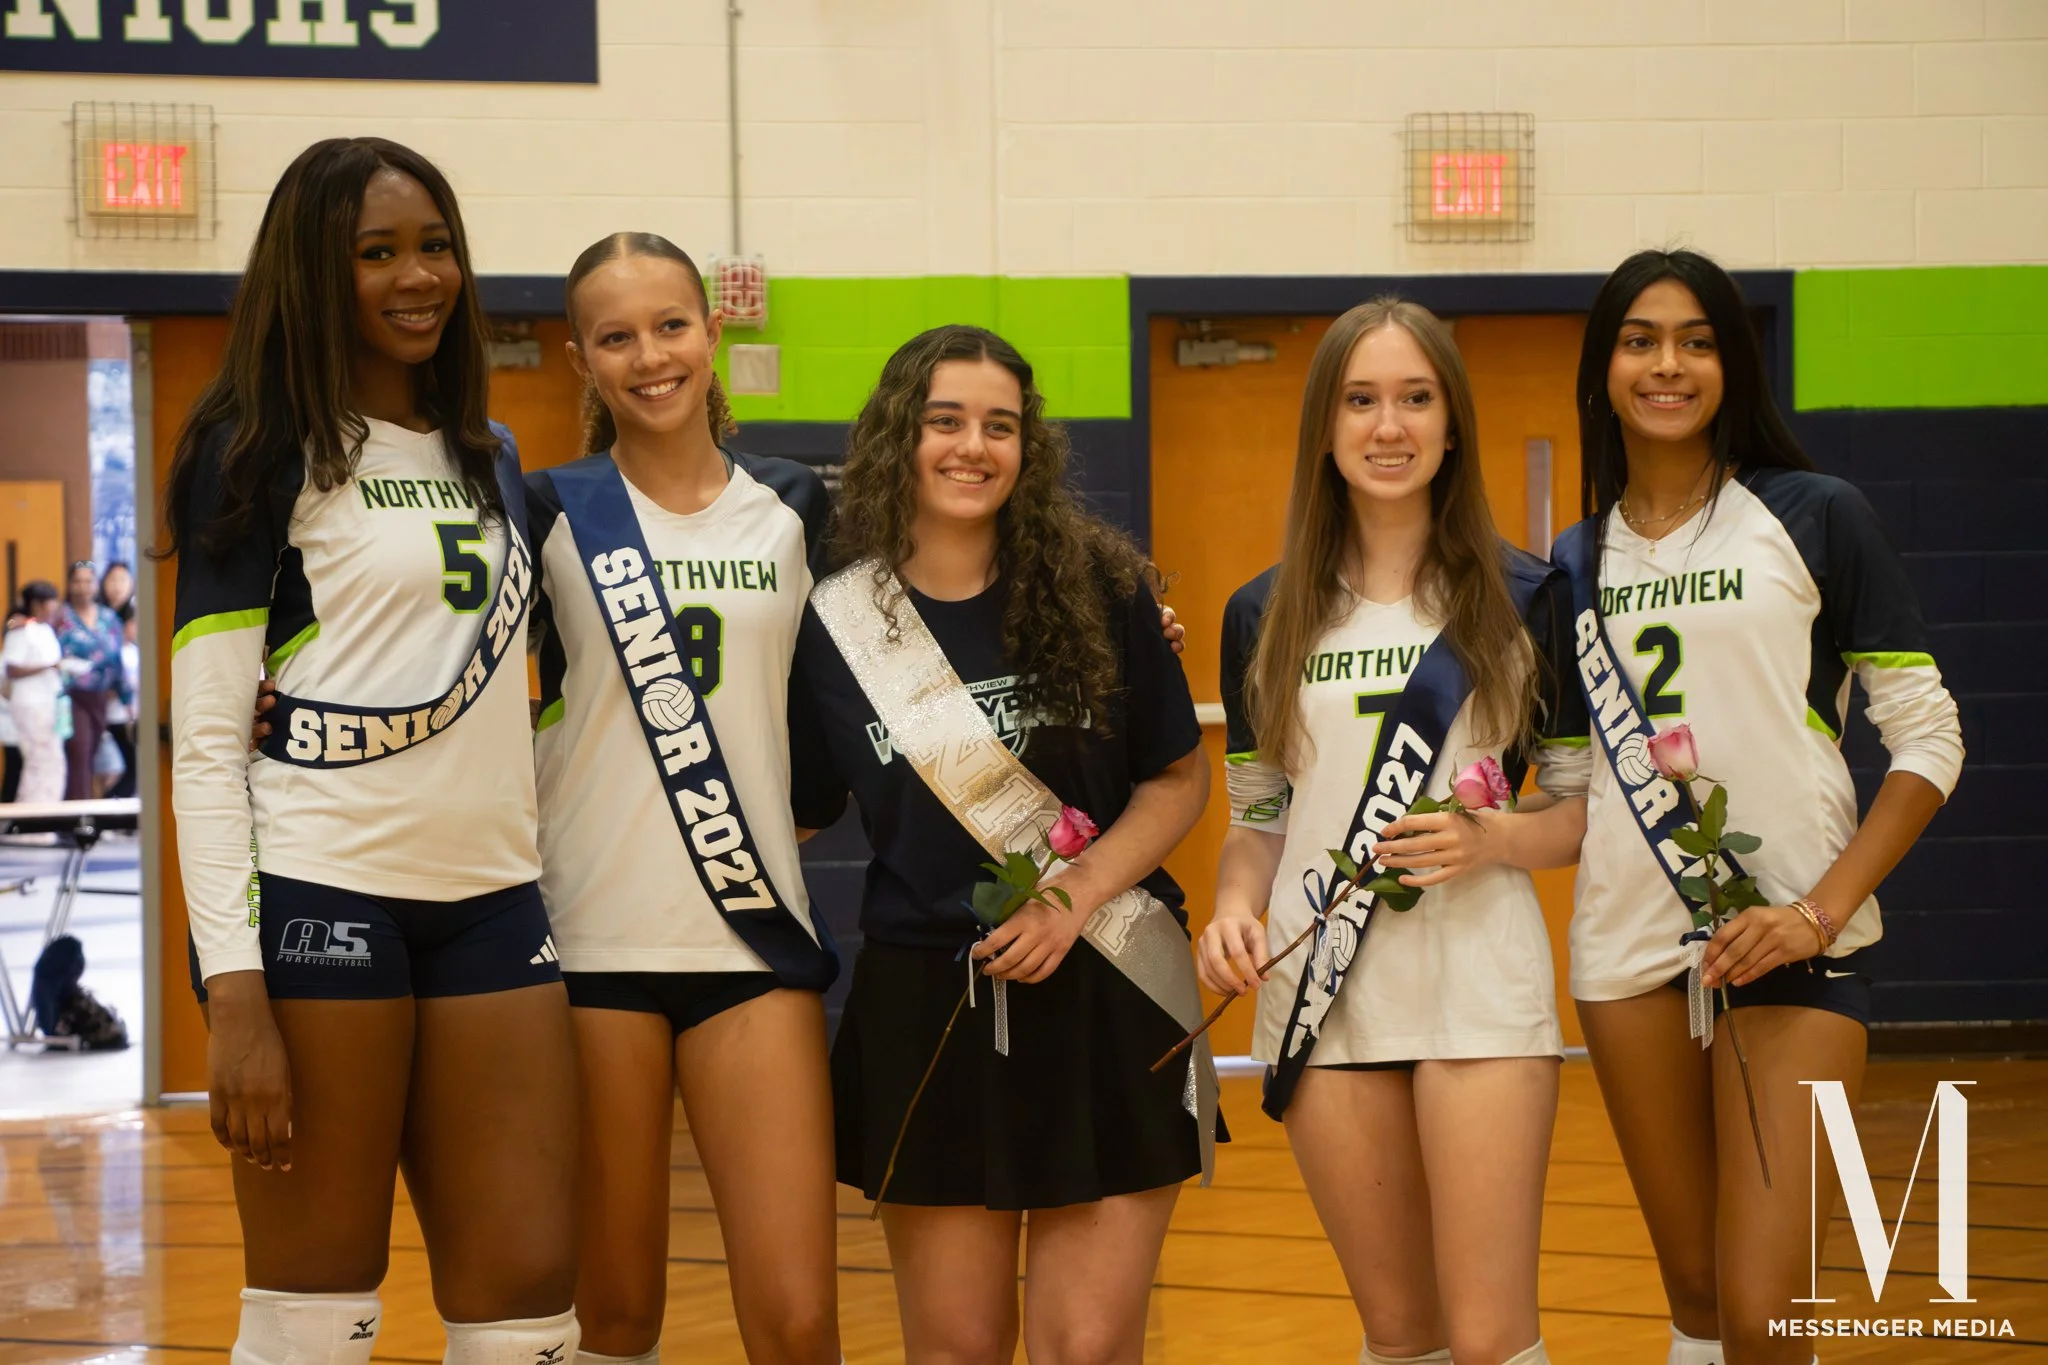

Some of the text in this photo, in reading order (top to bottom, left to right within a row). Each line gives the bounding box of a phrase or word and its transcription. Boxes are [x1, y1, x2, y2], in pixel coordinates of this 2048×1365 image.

[104, 143, 187, 207] EXIT
[1432, 154, 1507, 215] EXIT
[432, 521, 491, 614] 5
[486, 515, 533, 659] 2027
[664, 603, 725, 699] 8
[1632, 622, 1686, 719] 2
[675, 778, 777, 912] 2027
[1349, 721, 1434, 875] 2027
[279, 918, 371, 957] A5
